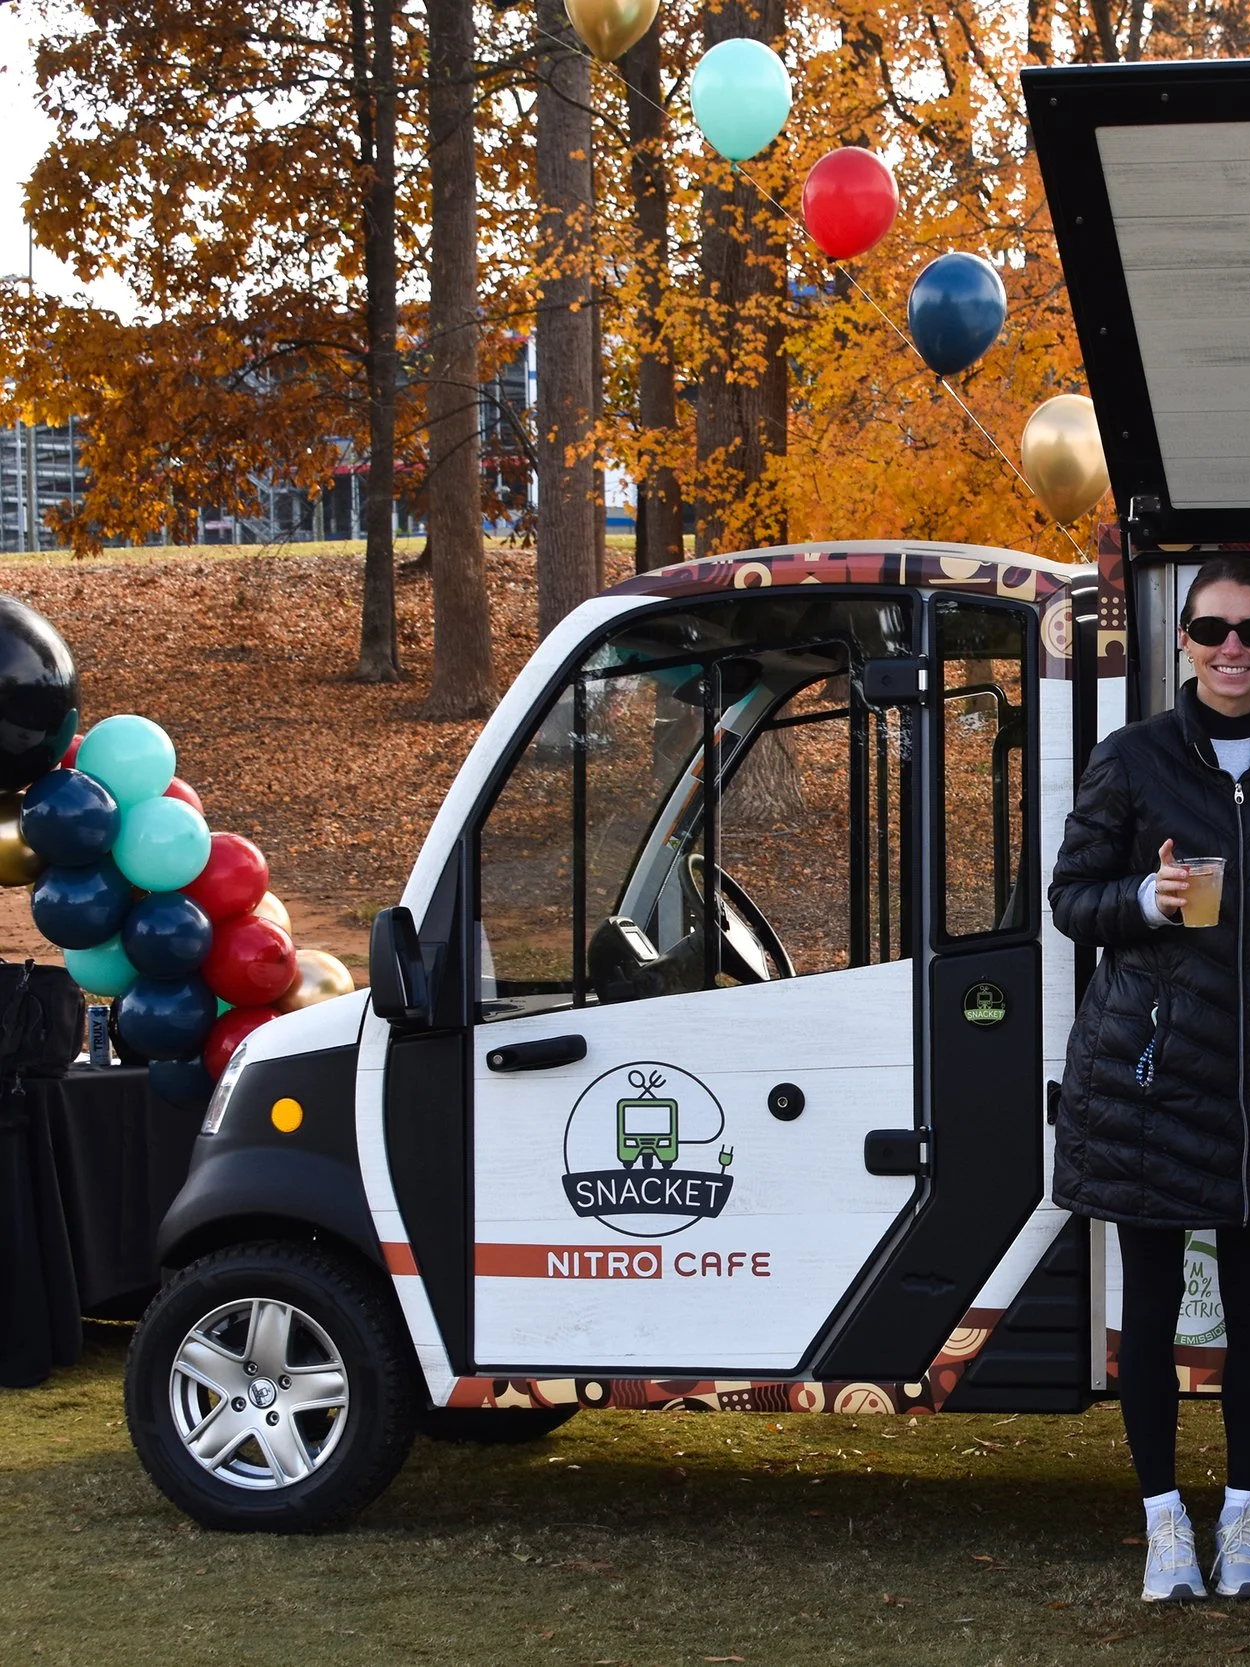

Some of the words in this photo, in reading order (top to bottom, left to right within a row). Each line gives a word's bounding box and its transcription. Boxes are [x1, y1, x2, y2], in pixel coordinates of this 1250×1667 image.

[967, 1010, 1003, 1019] SNACKET
[93, 1021, 103, 1051] TRULY
[575, 1177, 724, 1209] SNACKET
[546, 1251, 658, 1277] NITRO
[673, 1252, 771, 1277] CAFE
